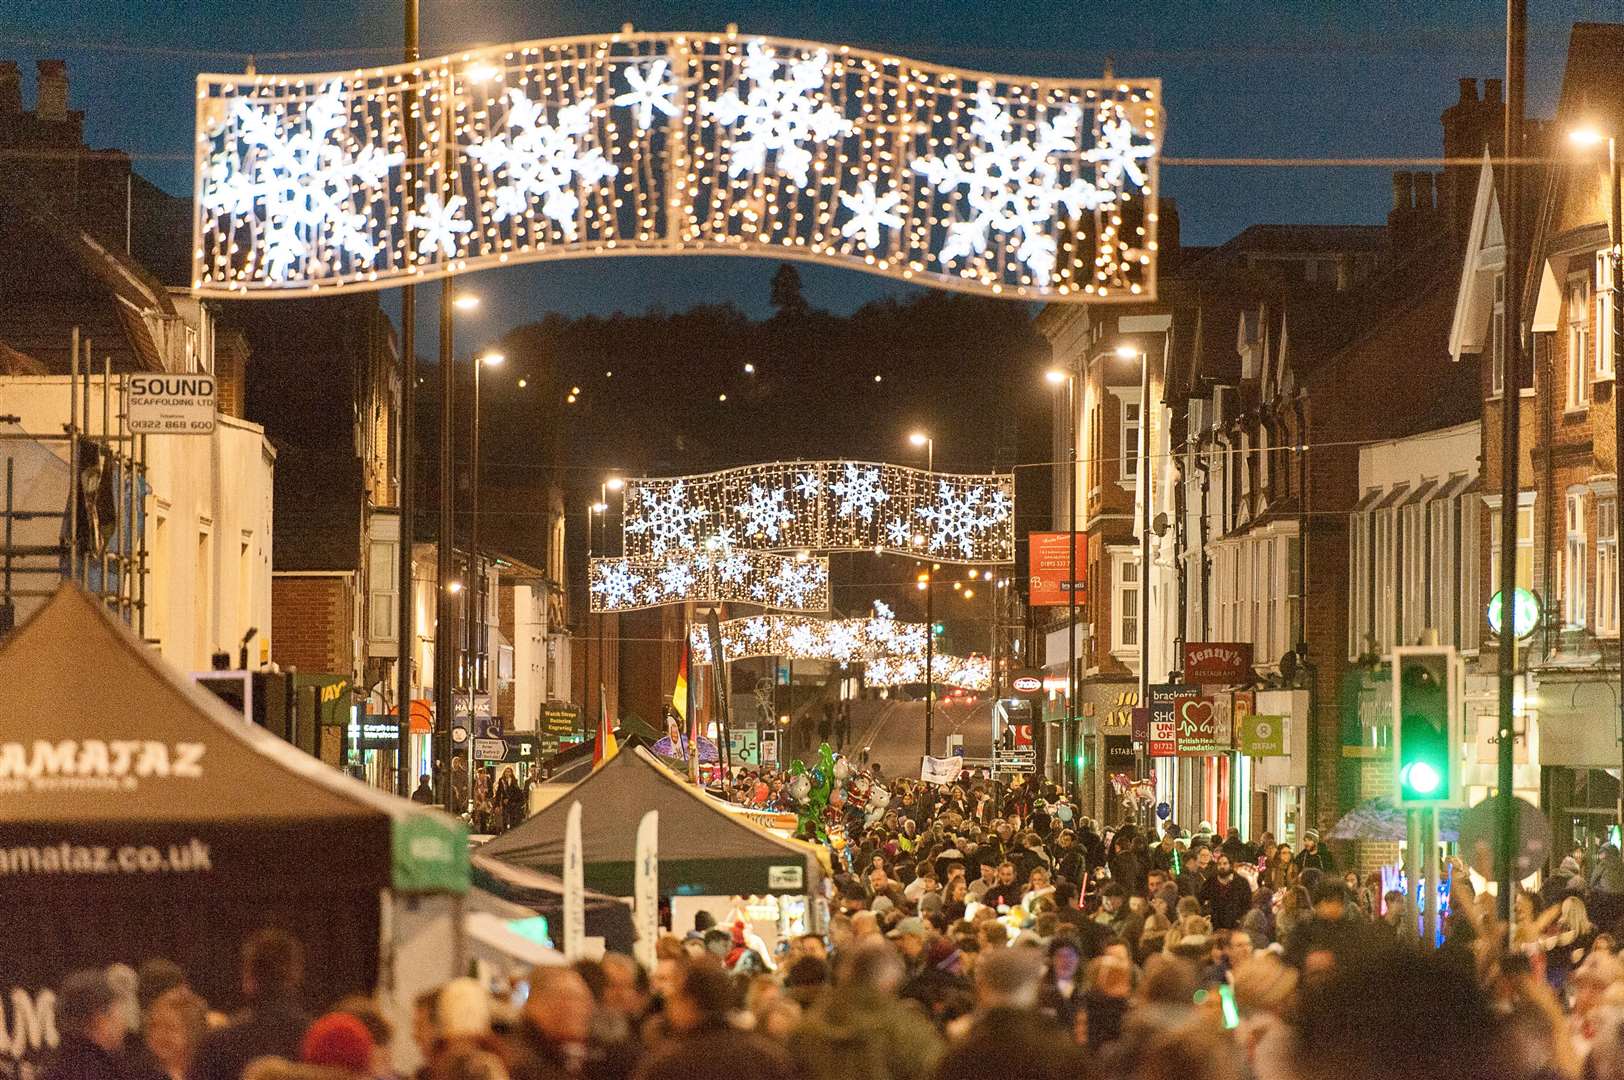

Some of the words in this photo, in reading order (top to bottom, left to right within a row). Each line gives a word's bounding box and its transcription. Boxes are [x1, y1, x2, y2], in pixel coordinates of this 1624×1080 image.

[131, 379, 213, 396] SOUND
[131, 398, 194, 406] SCAFFOLDING
[197, 398, 213, 406] LTD
[191, 421, 212, 429] 600
[1188, 648, 1242, 666] Jenny's
